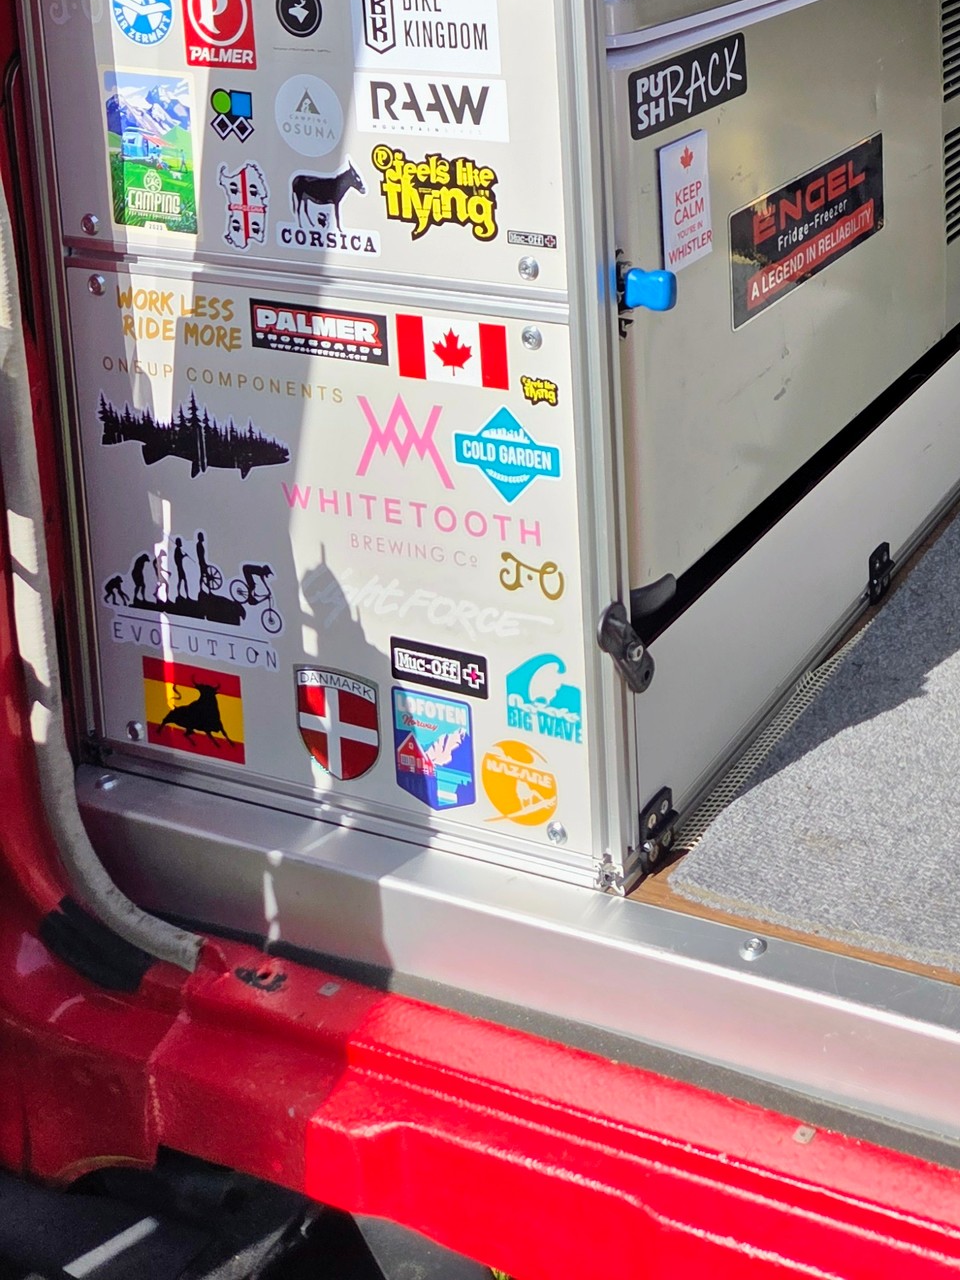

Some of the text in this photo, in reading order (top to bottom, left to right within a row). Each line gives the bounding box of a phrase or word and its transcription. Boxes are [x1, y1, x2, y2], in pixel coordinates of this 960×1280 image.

[114, 7, 171, 43] AIR ZERMATT
[403, 20, 488, 50] KINGDOM
[189, 46, 253, 64] PALMER
[662, 38, 742, 116] RACK
[369, 80, 490, 125] RAAW
[372, 124, 439, 132] MOUNTAIN
[386, 152, 495, 187] feels like
[128, 189, 181, 214] CAMPING
[382, 177, 496, 238] flying
[674, 197, 704, 225] CALM
[675, 180, 702, 207] KEEP
[753, 160, 865, 245] ENGEL
[281, 228, 377, 253] CORSICA
[777, 199, 848, 252] Fridge-Freezer
[668, 229, 712, 265] WHISTLER
[751, 206, 872, 301] A LEGEND IN RELIABILITY
[116, 286, 235, 322] WORK LESS
[123, 316, 242, 352] RIDE MORE
[256, 308, 377, 344] PALMER
[256, 332, 382, 355] SNOWBOARDS
[103, 356, 343, 404] ONEUP COMPONENTS
[462, 439, 551, 470] COLD GARDEN
[281, 481, 542, 547] WHITETOOTH
[351, 533, 445, 563] BREWING
[114, 622, 277, 669] EVOLUTION
[398, 651, 457, 680] Muc-Off
[300, 671, 373, 700] DANMARK
[397, 694, 467, 727] LOFOTEN
[402, 713, 438, 732] Norway
[507, 707, 583, 744] BIG WAVE
